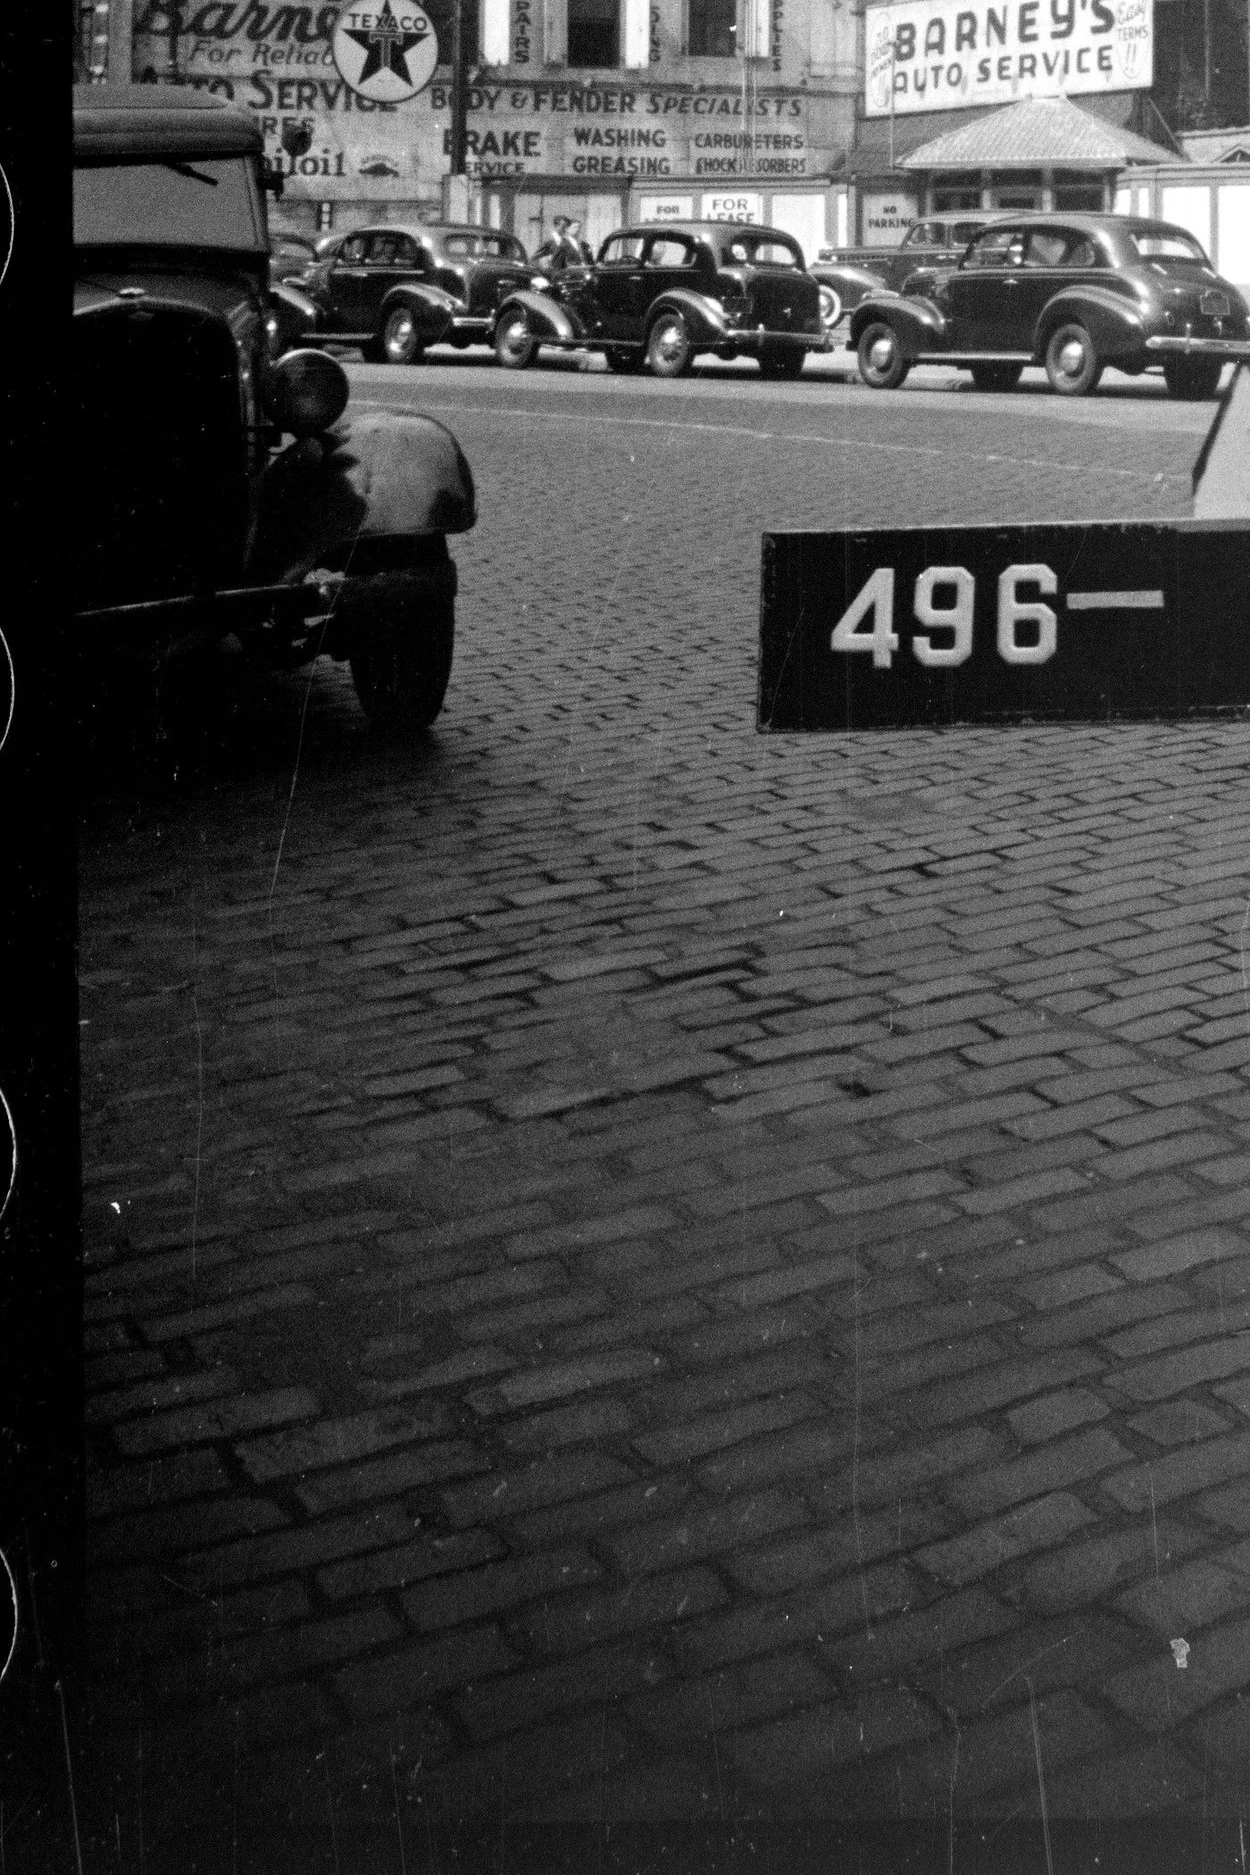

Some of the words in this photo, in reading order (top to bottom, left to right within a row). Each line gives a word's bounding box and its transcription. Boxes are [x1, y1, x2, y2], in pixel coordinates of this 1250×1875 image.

[349, 13, 428, 32] TEXACO
[1117, 25, 1149, 41] TERMS
[189, 40, 242, 62] For
[252, 43, 335, 65] Reliab
[893, 62, 963, 94] AUTO
[977, 45, 1114, 82] SERVICE
[431, 88, 502, 112] BDY
[511, 91, 529, 110] &
[533, 89, 637, 114] FENDER
[646, 92, 802, 117] SPECIALISTS
[574, 127, 667, 148] WASHING
[465, 162, 525, 174] ERVICE
[572, 156, 671, 175] GREASING
[656, 205, 680, 215] FOR
[713, 198, 748, 211] FOR
[883, 206, 898, 214] NO
